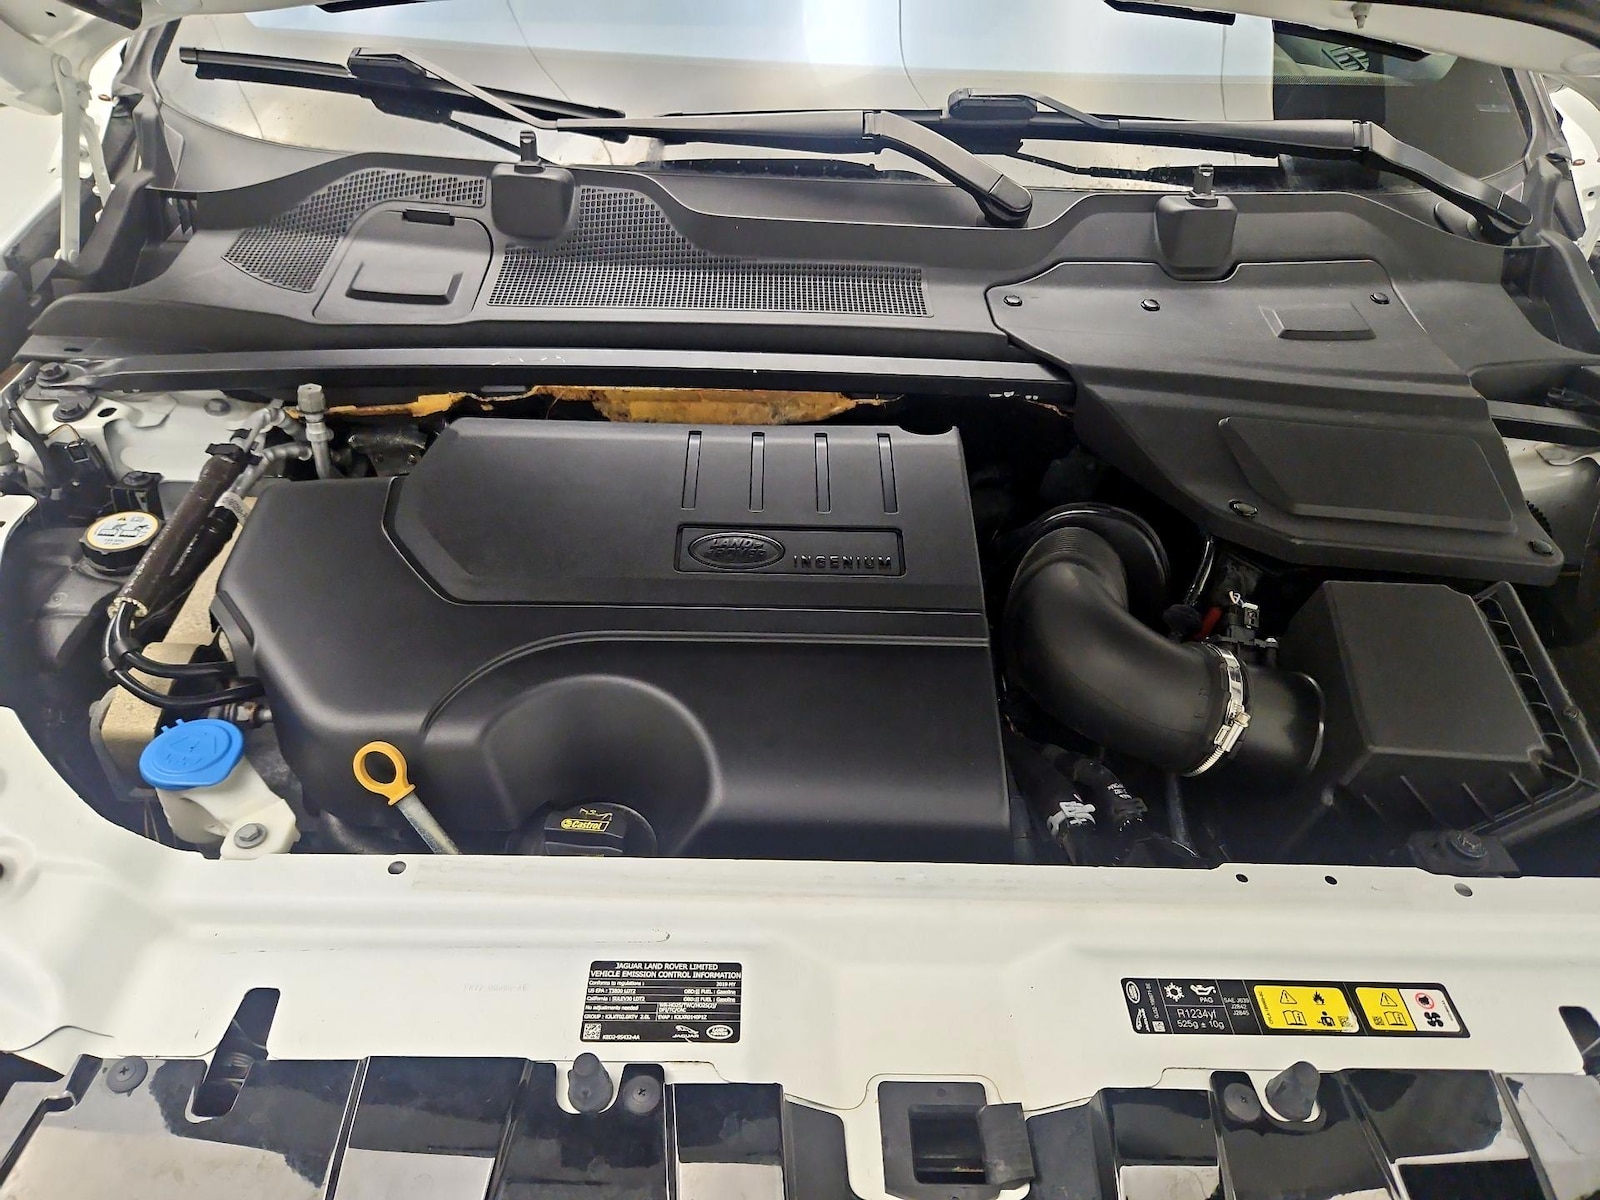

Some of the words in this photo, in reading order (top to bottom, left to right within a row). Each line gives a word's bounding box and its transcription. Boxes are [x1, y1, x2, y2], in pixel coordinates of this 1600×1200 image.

[712, 538, 753, 549] LAND
[793, 555, 892, 570] INGENIUM
[572, 820, 602, 830] Castrol
[689, 963, 719, 971] LIMITED
[590, 970, 621, 978] VEHICLE
[622, 970, 657, 978] EMISSION
[658, 970, 691, 979] CONTROL
[692, 971, 742, 979] INFORMATION
[1177, 1009, 1217, 1021] R1234yf
[1177, 1020, 1200, 1030] 525g
[1209, 1021, 1225, 1030] 10g
